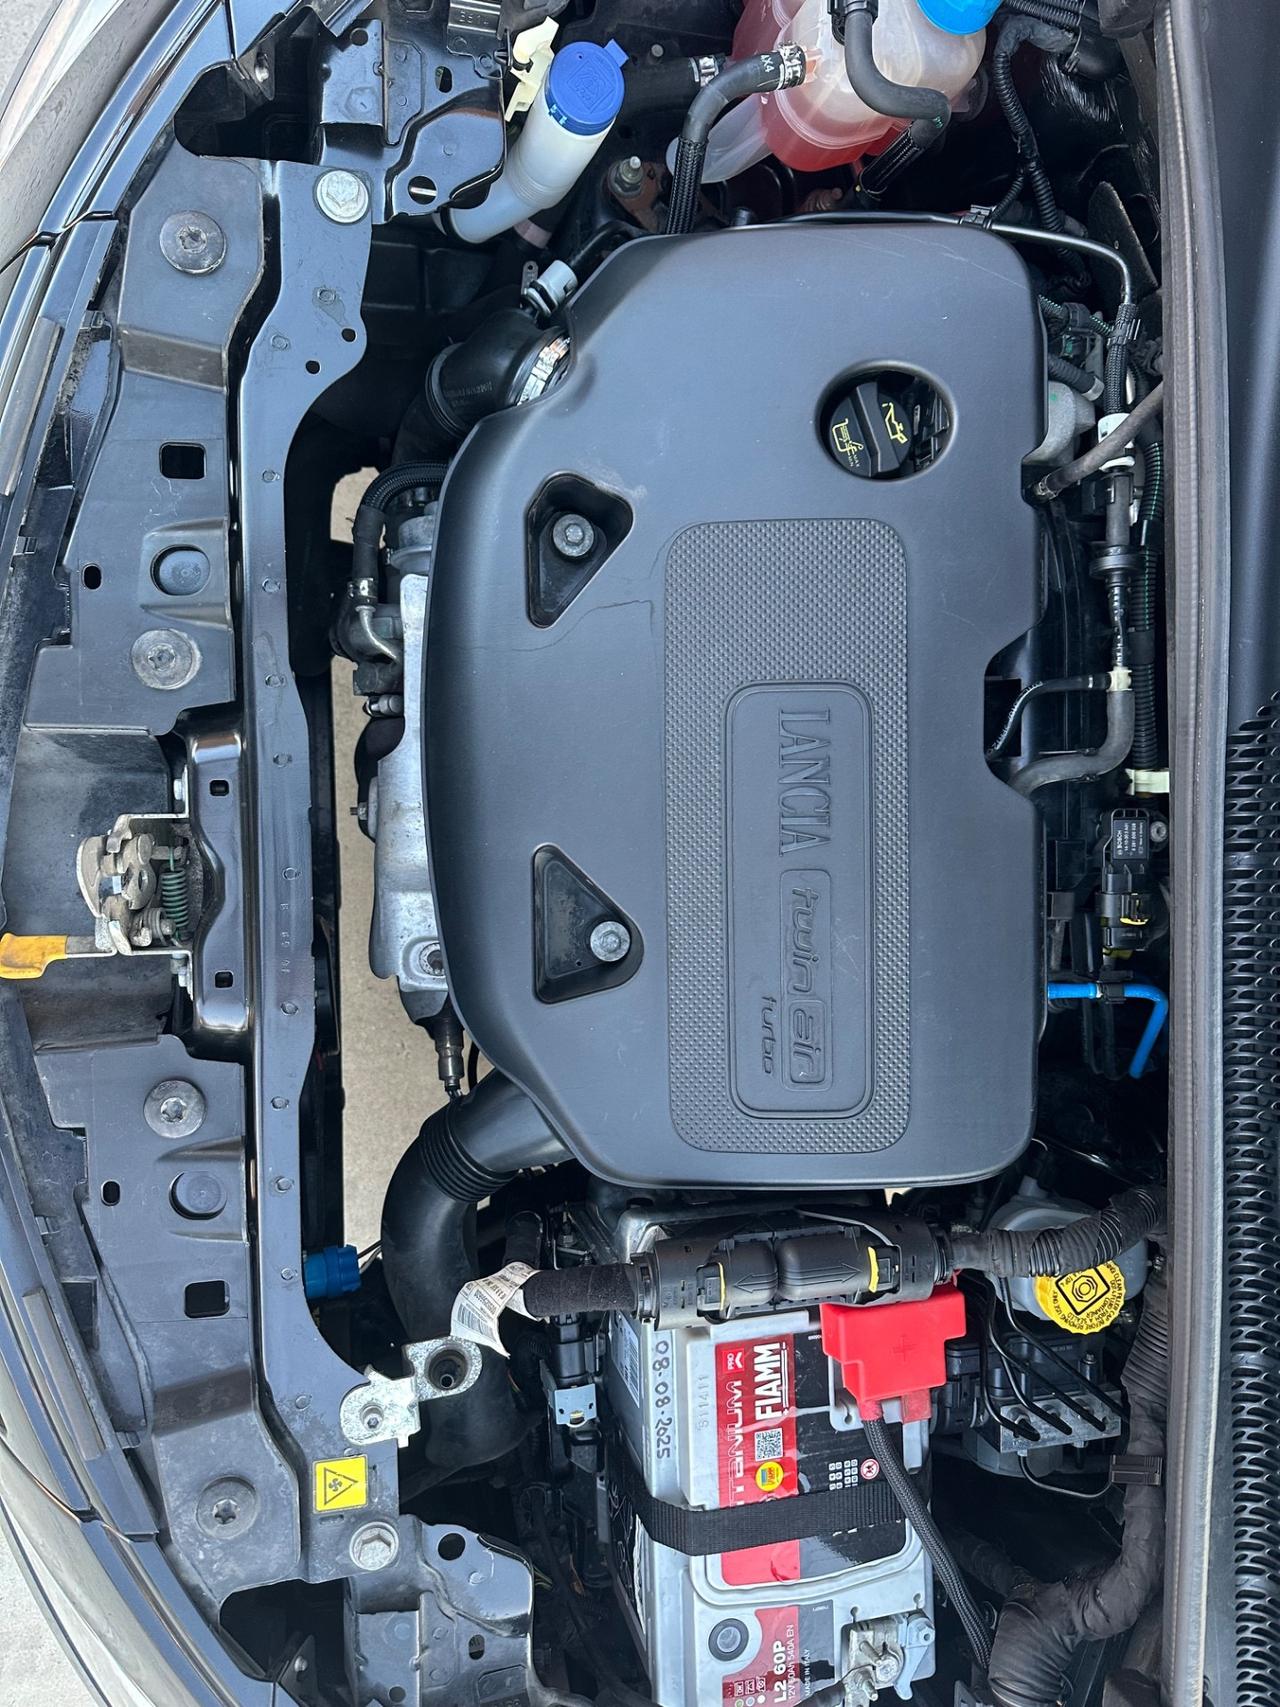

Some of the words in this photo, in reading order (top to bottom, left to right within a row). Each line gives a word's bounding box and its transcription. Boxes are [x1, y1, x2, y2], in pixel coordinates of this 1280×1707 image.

[777, 706, 831, 857] LANCIA
[790, 887, 820, 995] twin
[759, 995, 777, 1076] turbo
[790, 1007, 820, 1078] air
[1113, 1273, 1123, 1291] CLEAN
[1113, 1292, 1123, 1311] FILLER
[1104, 1310, 1115, 1322] CAP
[727, 1352, 735, 1370] PRO
[753, 1342, 783, 1421] FIAMM
[726, 1380, 745, 1506] ITANIUM
[786, 1624, 795, 1637] EN
[773, 1640, 787, 1675] 60P
[786, 1639, 795, 1660] 540A
[803, 1648, 811, 1667] ITALY
[774, 1680, 787, 1703] L2
[787, 1684, 796, 1700] 12V
